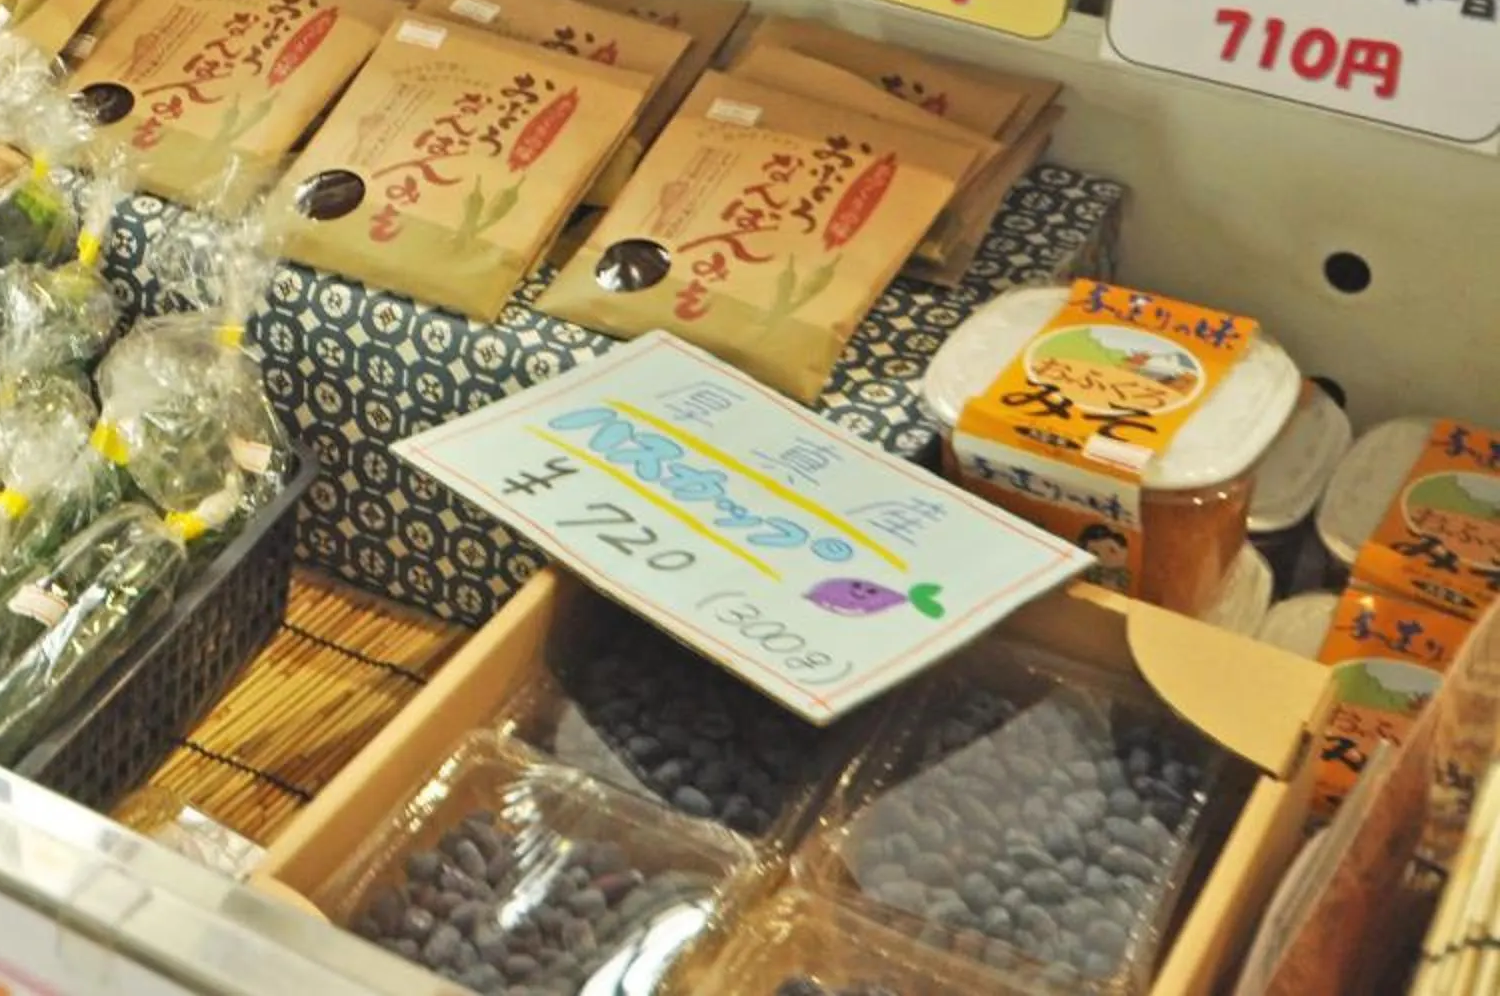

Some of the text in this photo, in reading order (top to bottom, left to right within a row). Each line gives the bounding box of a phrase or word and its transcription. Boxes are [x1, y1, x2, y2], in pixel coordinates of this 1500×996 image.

[1215, 8, 1402, 100] 710円
[999, 377, 1159, 443] みそ
[547, 405, 854, 565] ハスカップ
